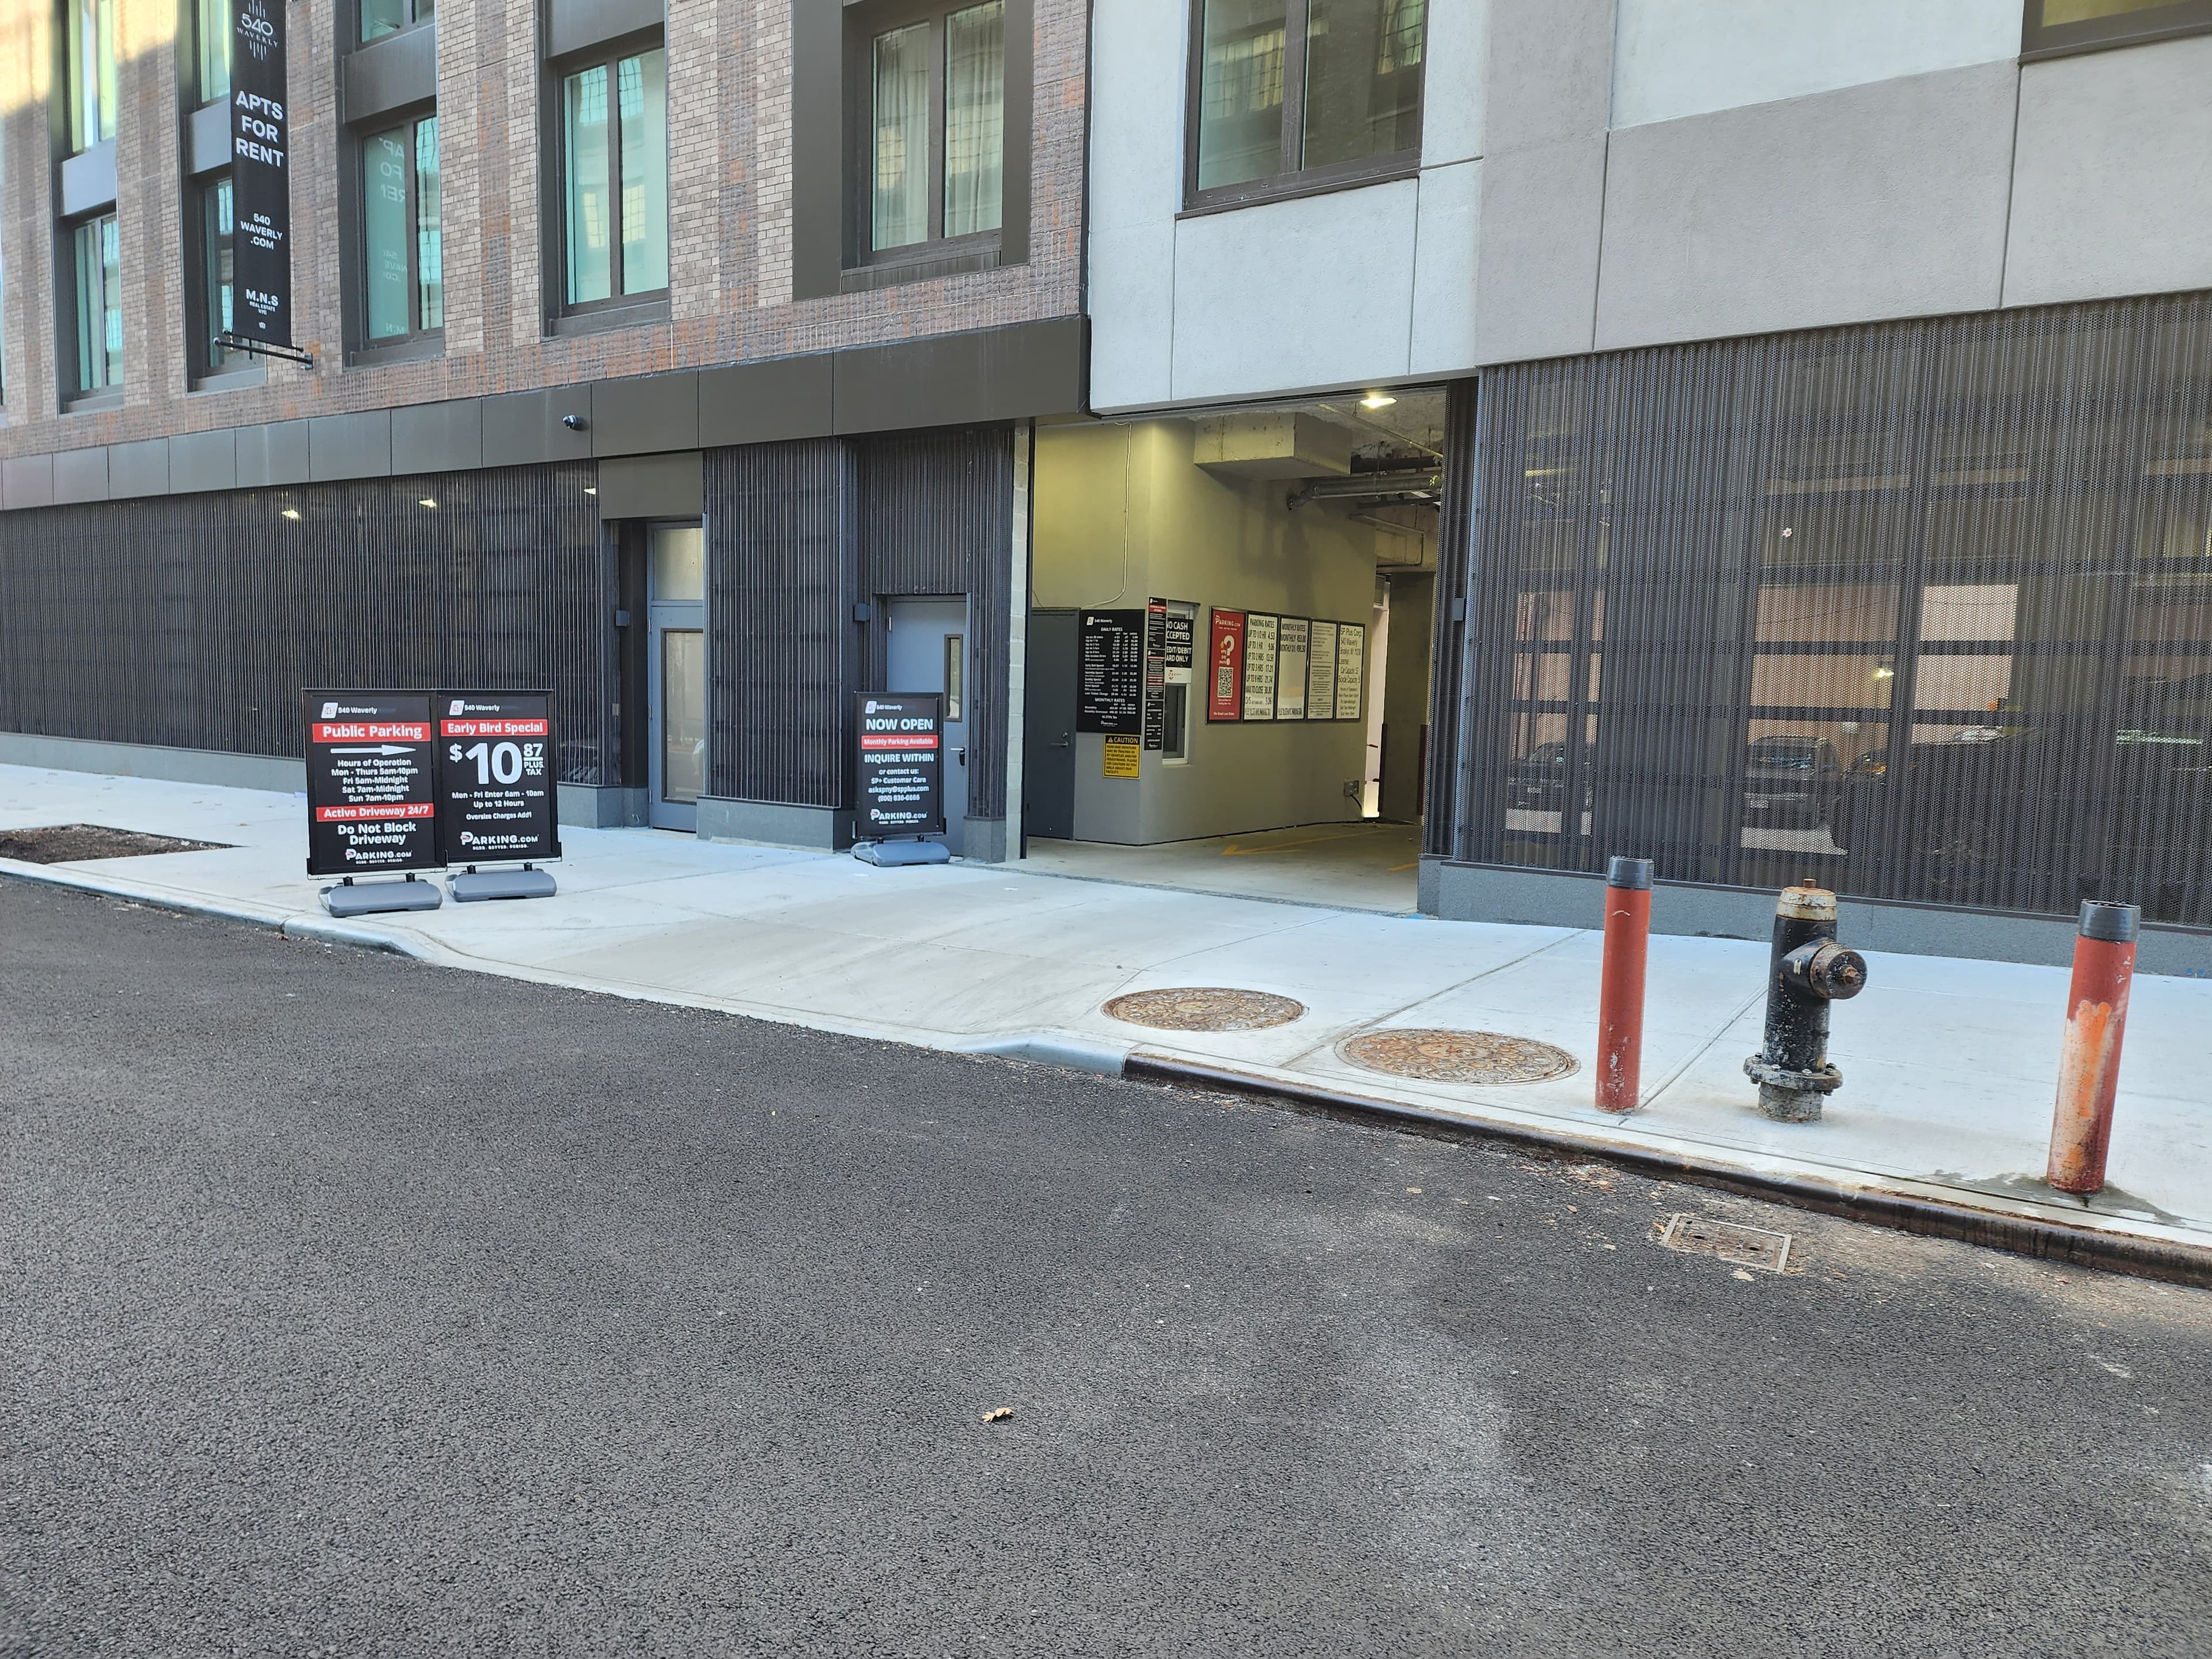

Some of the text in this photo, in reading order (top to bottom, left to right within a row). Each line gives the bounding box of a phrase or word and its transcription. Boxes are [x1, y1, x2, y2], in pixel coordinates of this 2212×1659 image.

[241, 13, 273, 36] 540
[237, 27, 278, 48] WAVERLY
[236, 90, 283, 120] APTS
[242, 115, 278, 143] FOR
[236, 138, 284, 168] RENT
[253, 213, 271, 226] 540
[240, 221, 283, 241] WAVERLY
[251, 236, 274, 250] .COM
[246, 289, 279, 306] M.N.S
[1173, 622, 1188, 630] CASH
[1250, 618, 1274, 628] PARKING RATES
[1166, 631, 1190, 640] CCEPTED
[476, 704, 500, 712] Waverly
[448, 722, 543, 735] Early Bird Special
[866, 718, 933, 730] NOW OPEN
[323, 724, 422, 739] Public Parking
[888, 738, 909, 746] Parking
[523, 743, 543, 757] 87
[373, 758, 411, 767] Operation
[864, 753, 934, 764] INQUIRE WITHIN
[357, 785, 410, 793] 7am-Midnight
[365, 794, 404, 802] 7am-10pm
[324, 805, 429, 818] Active Driveway 24/7
[474, 801, 483, 809] Up
[493, 812, 517, 820] Charges
[338, 821, 416, 835] Do Not Block
[350, 834, 406, 845] Driveway
